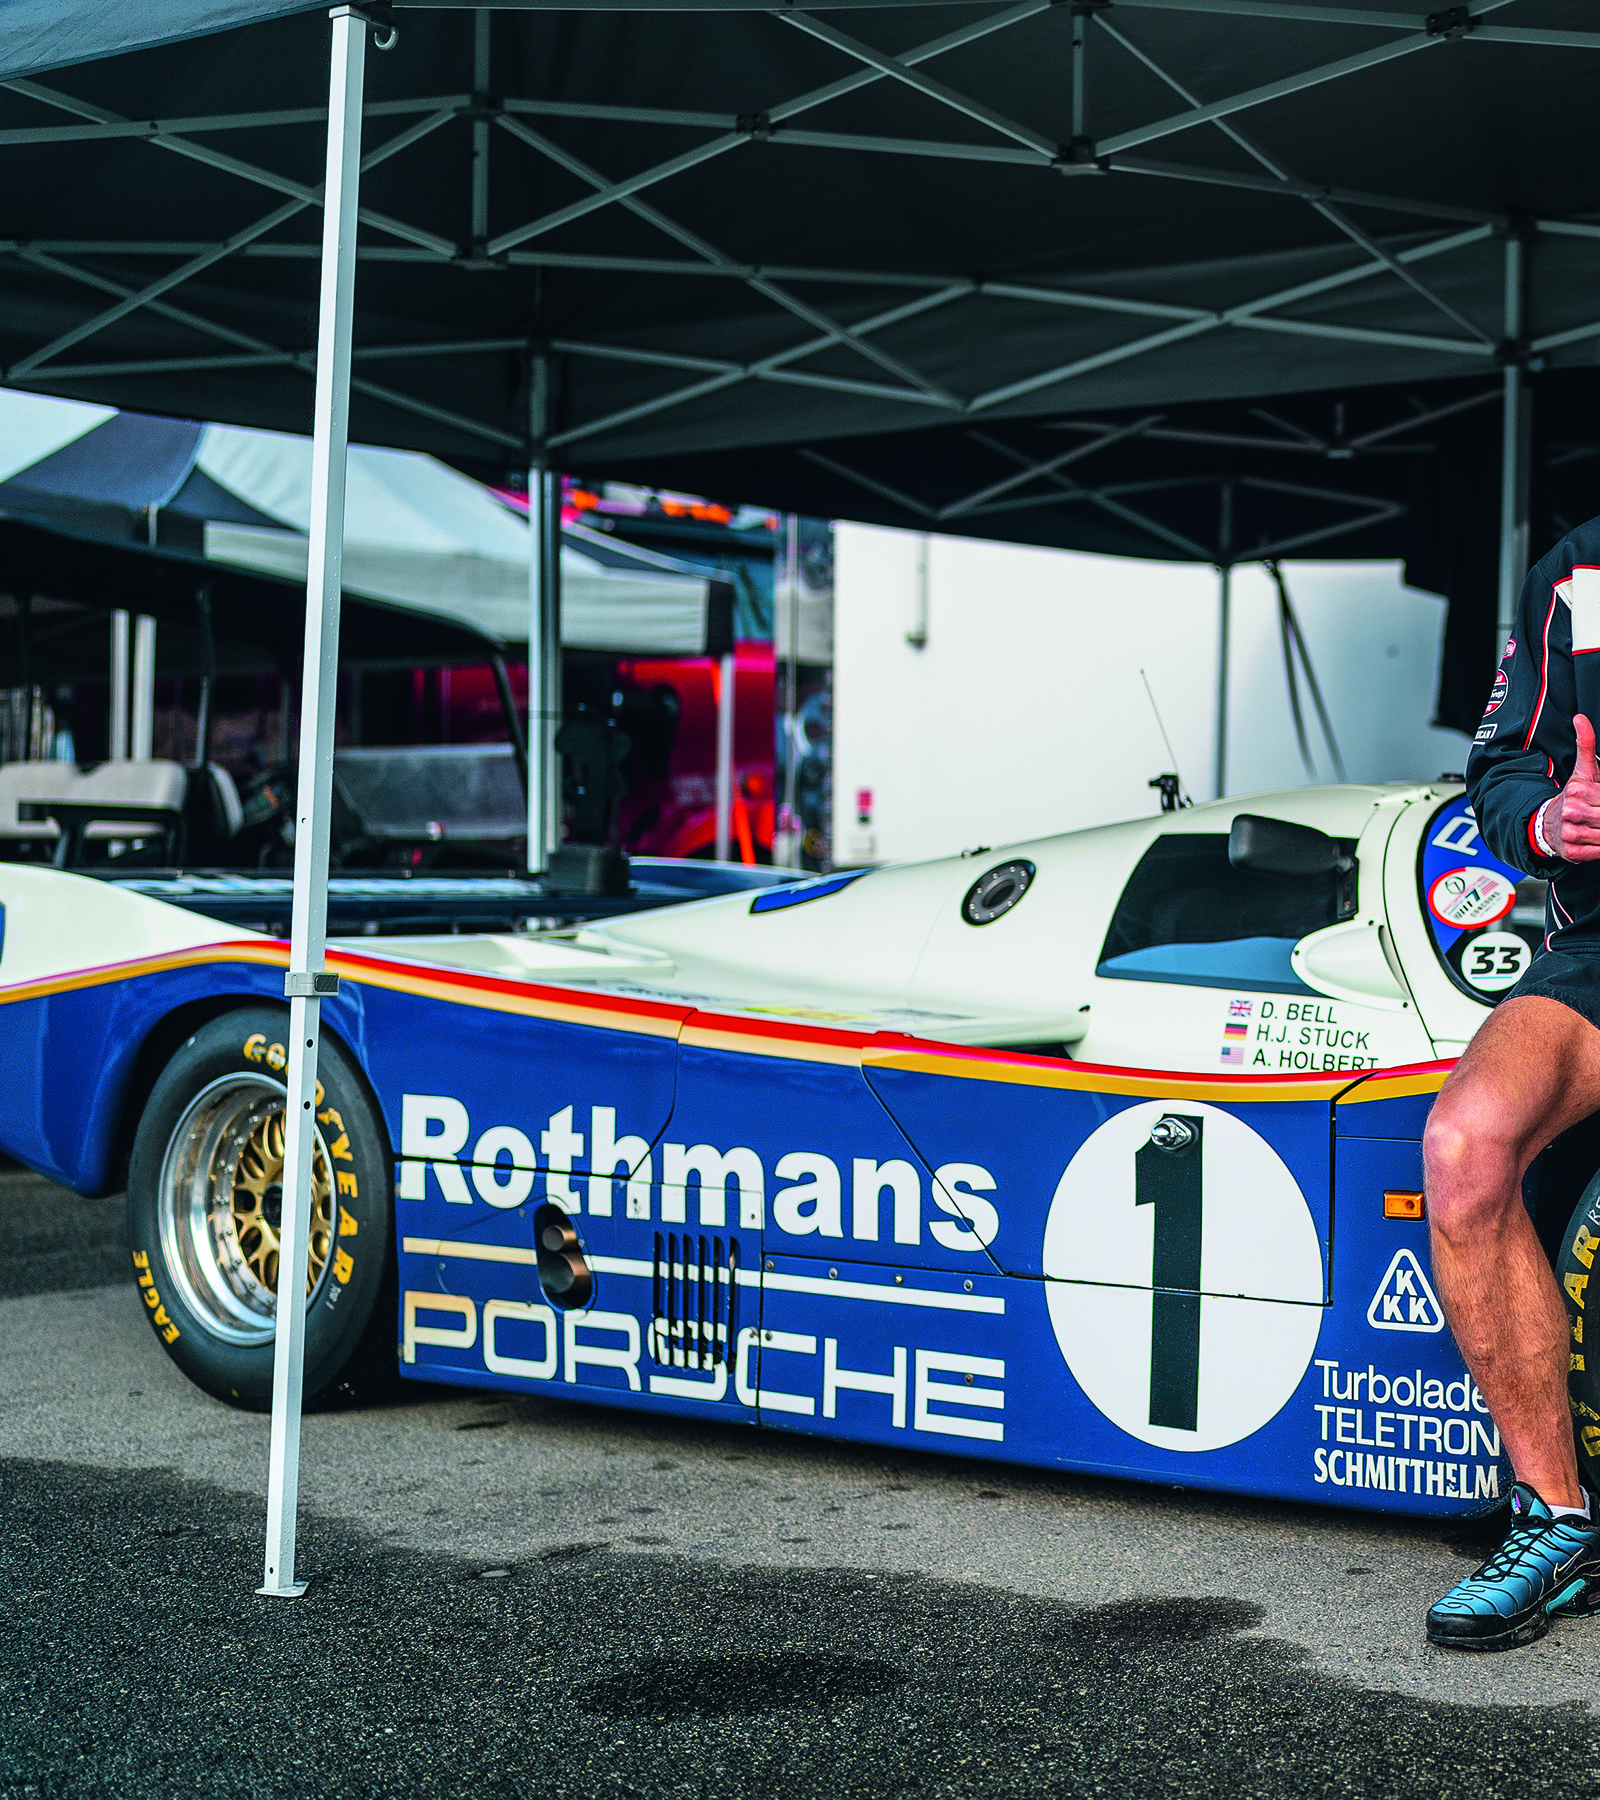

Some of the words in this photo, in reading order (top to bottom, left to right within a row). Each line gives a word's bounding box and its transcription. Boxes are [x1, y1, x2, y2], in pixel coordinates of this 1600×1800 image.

[1471, 946, 1522, 974] 33
[1256, 1024, 1291, 1044] H.J.
[1299, 1028, 1370, 1050] STUCK
[1260, 1002, 1278, 1020] D.
[1286, 1003, 1338, 1024] BELL
[1253, 1049, 1272, 1067] A.
[243, 1034, 360, 1286] GOYEAR
[399, 1094, 1000, 1252] Rothmans
[133, 1249, 181, 1345] EAGLE
[1135, 1113, 1204, 1432] 1
[403, 1290, 1005, 1442] PORSCHE
[1314, 1359, 1490, 1414] Turbolade
[1314, 1404, 1500, 1457] TELETRON
[1314, 1448, 1500, 1500] SCHMITTHELM
